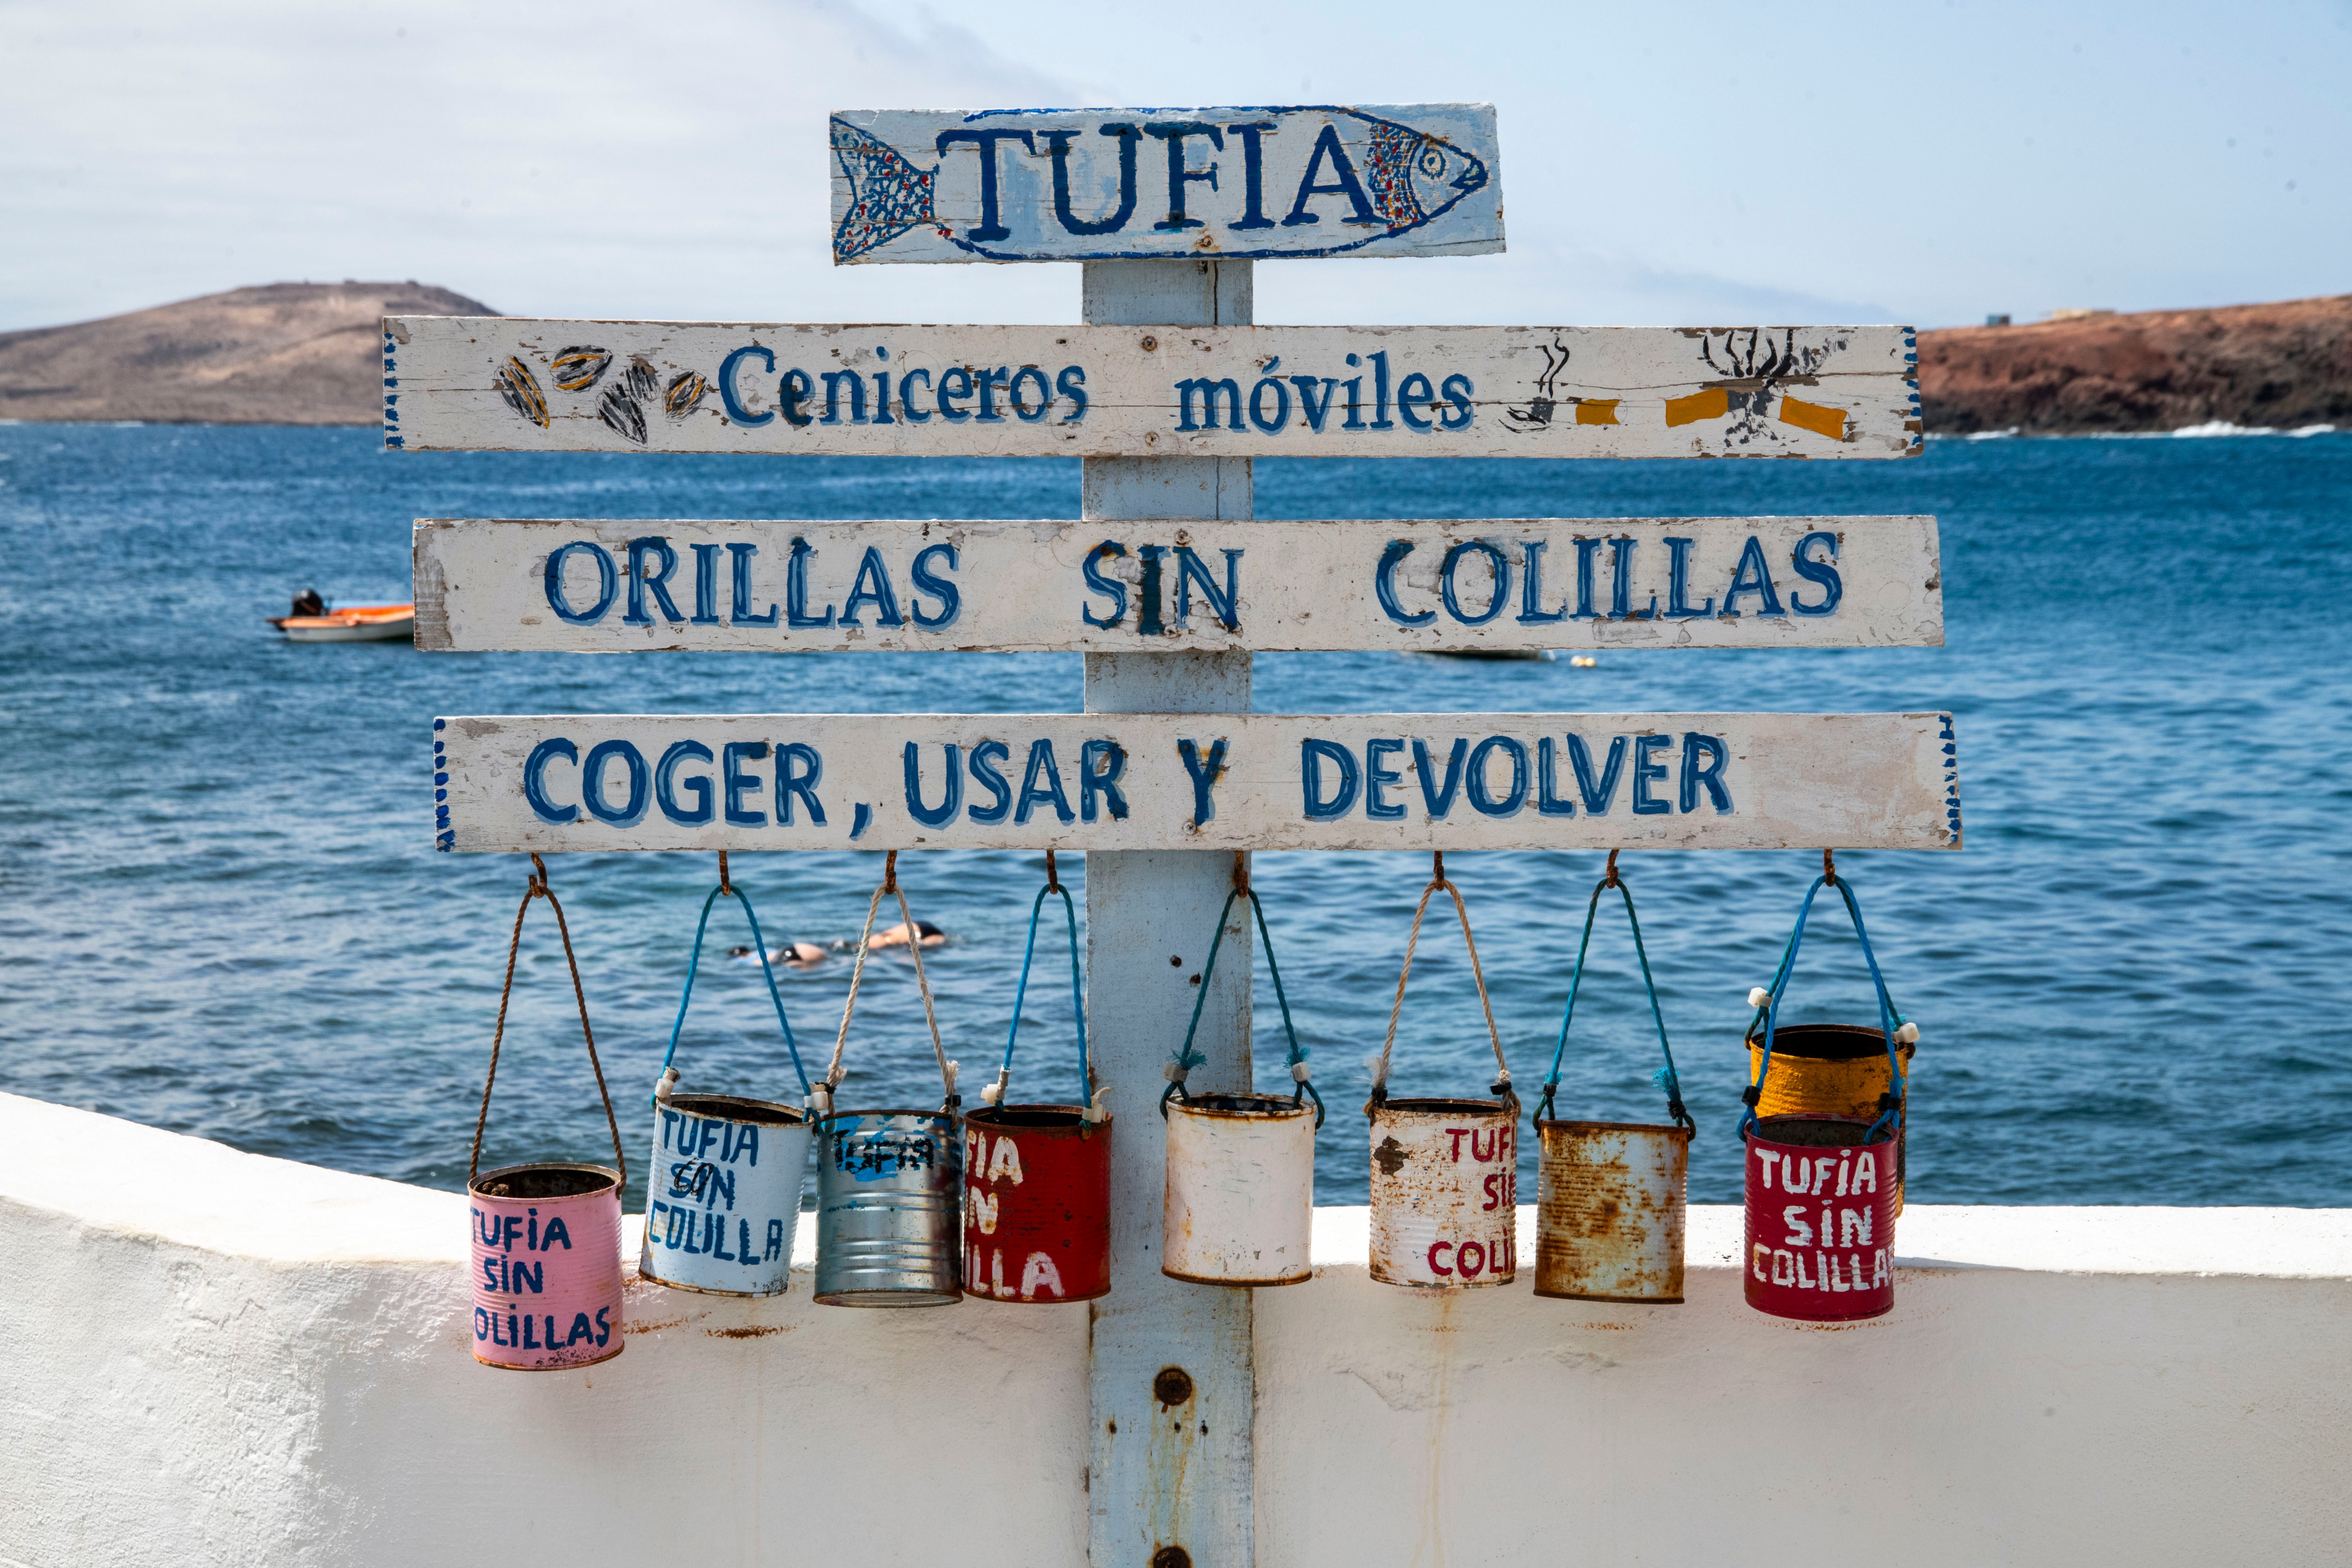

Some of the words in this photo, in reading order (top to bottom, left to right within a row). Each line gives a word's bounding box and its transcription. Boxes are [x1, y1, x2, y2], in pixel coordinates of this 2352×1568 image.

[936, 121, 1392, 242] TUFIA
[718, 346, 1089, 428] Ceniceros
[1174, 350, 1474, 434] móviles
[545, 536, 961, 632] ORILLAS
[1082, 540, 1246, 636] SIN
[1375, 531, 1843, 628] COLILLAS
[904, 739, 1130, 831] USAR
[1177, 739, 1232, 828] Y
[1301, 731, 1735, 819] DEVOLVER
[649, 1199, 783, 1265] COLILLA
